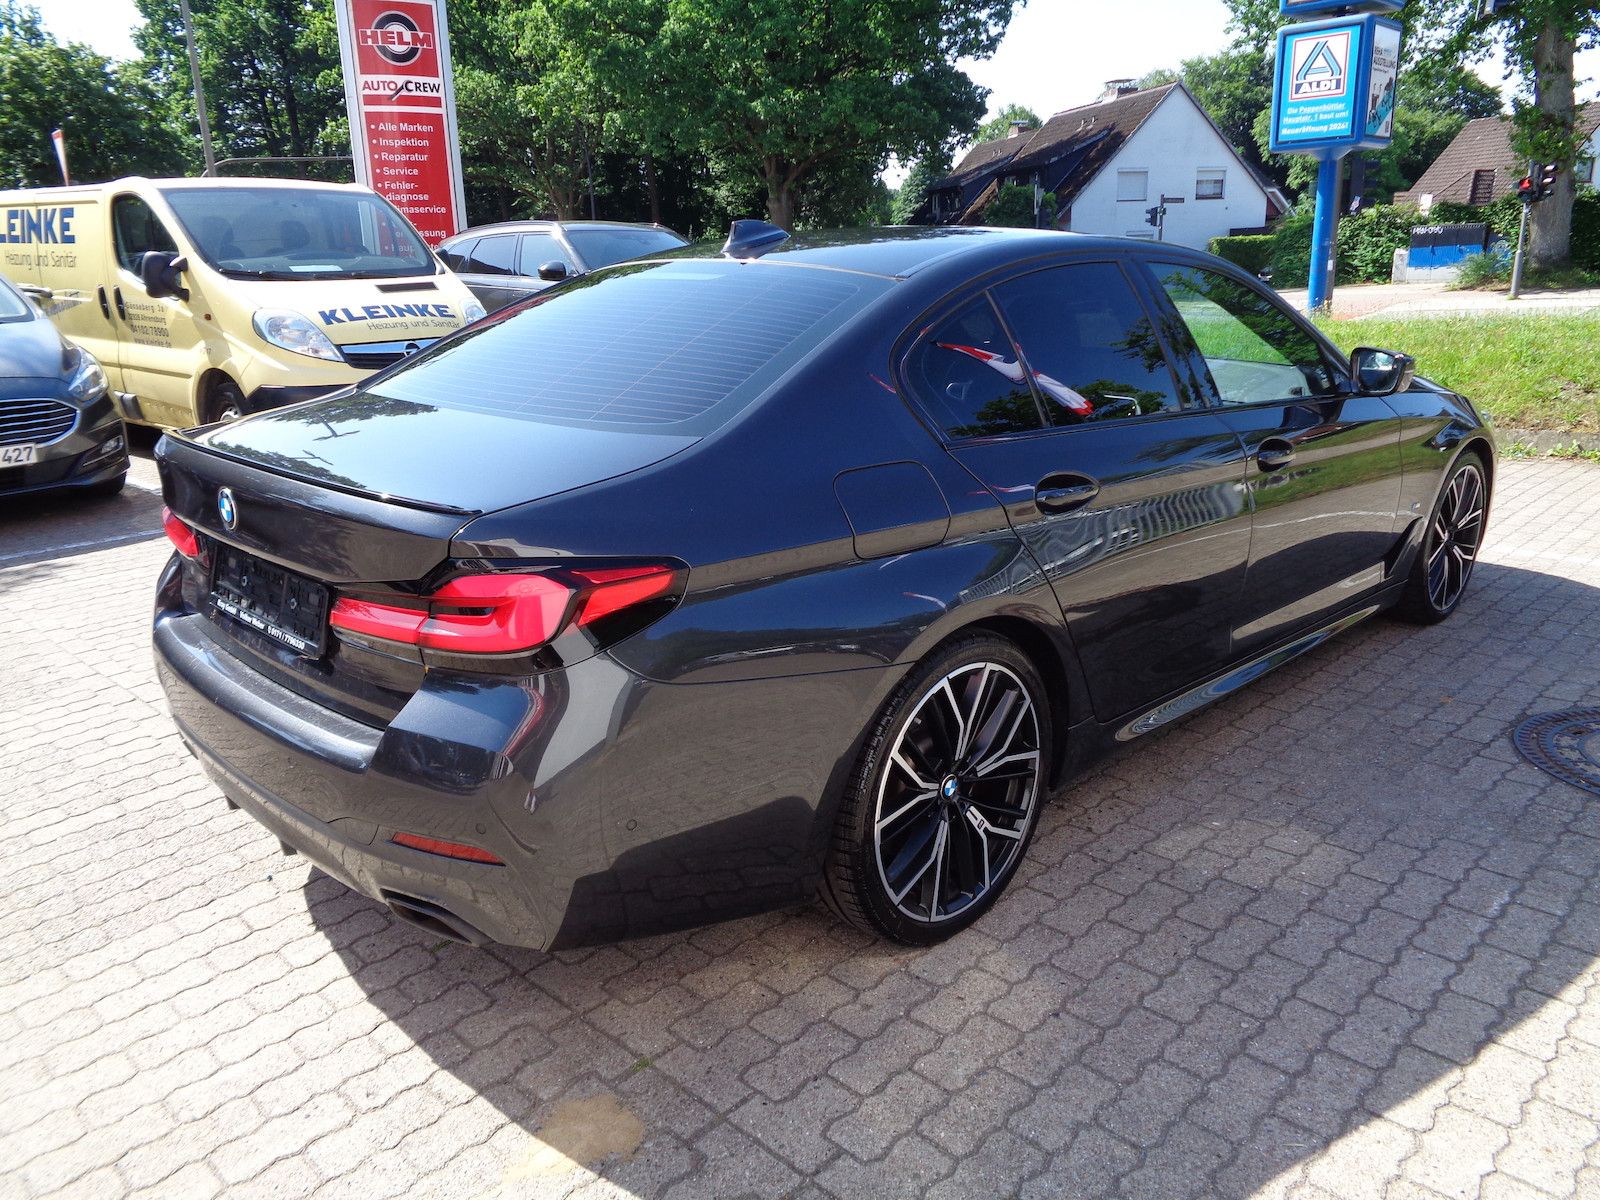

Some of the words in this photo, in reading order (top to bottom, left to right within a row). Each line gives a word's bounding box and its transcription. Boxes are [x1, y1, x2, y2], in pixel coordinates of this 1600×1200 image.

[359, 29, 433, 49] HELM
[362, 80, 397, 92] AUTO
[404, 80, 440, 94] CREW
[1299, 79, 1338, 94] ALDI
[378, 122, 397, 132] Alle
[400, 122, 434, 133] Marken
[379, 137, 429, 147] Inspektion
[381, 152, 428, 162] Reparatur
[383, 166, 419, 176] Service
[384, 181, 419, 190] Fehler-
[386, 192, 429, 202] diagnose
[5, 250, 32, 271] Heizung
[34, 249, 49, 267] und
[50, 250, 77, 268] Sanitär
[318, 303, 457, 326] KLEINKE
[367, 321, 409, 331] Heizung
[409, 320, 430, 328] und
[430, 319, 461, 329] Sanitär
[2, 446, 33, 464] 427
